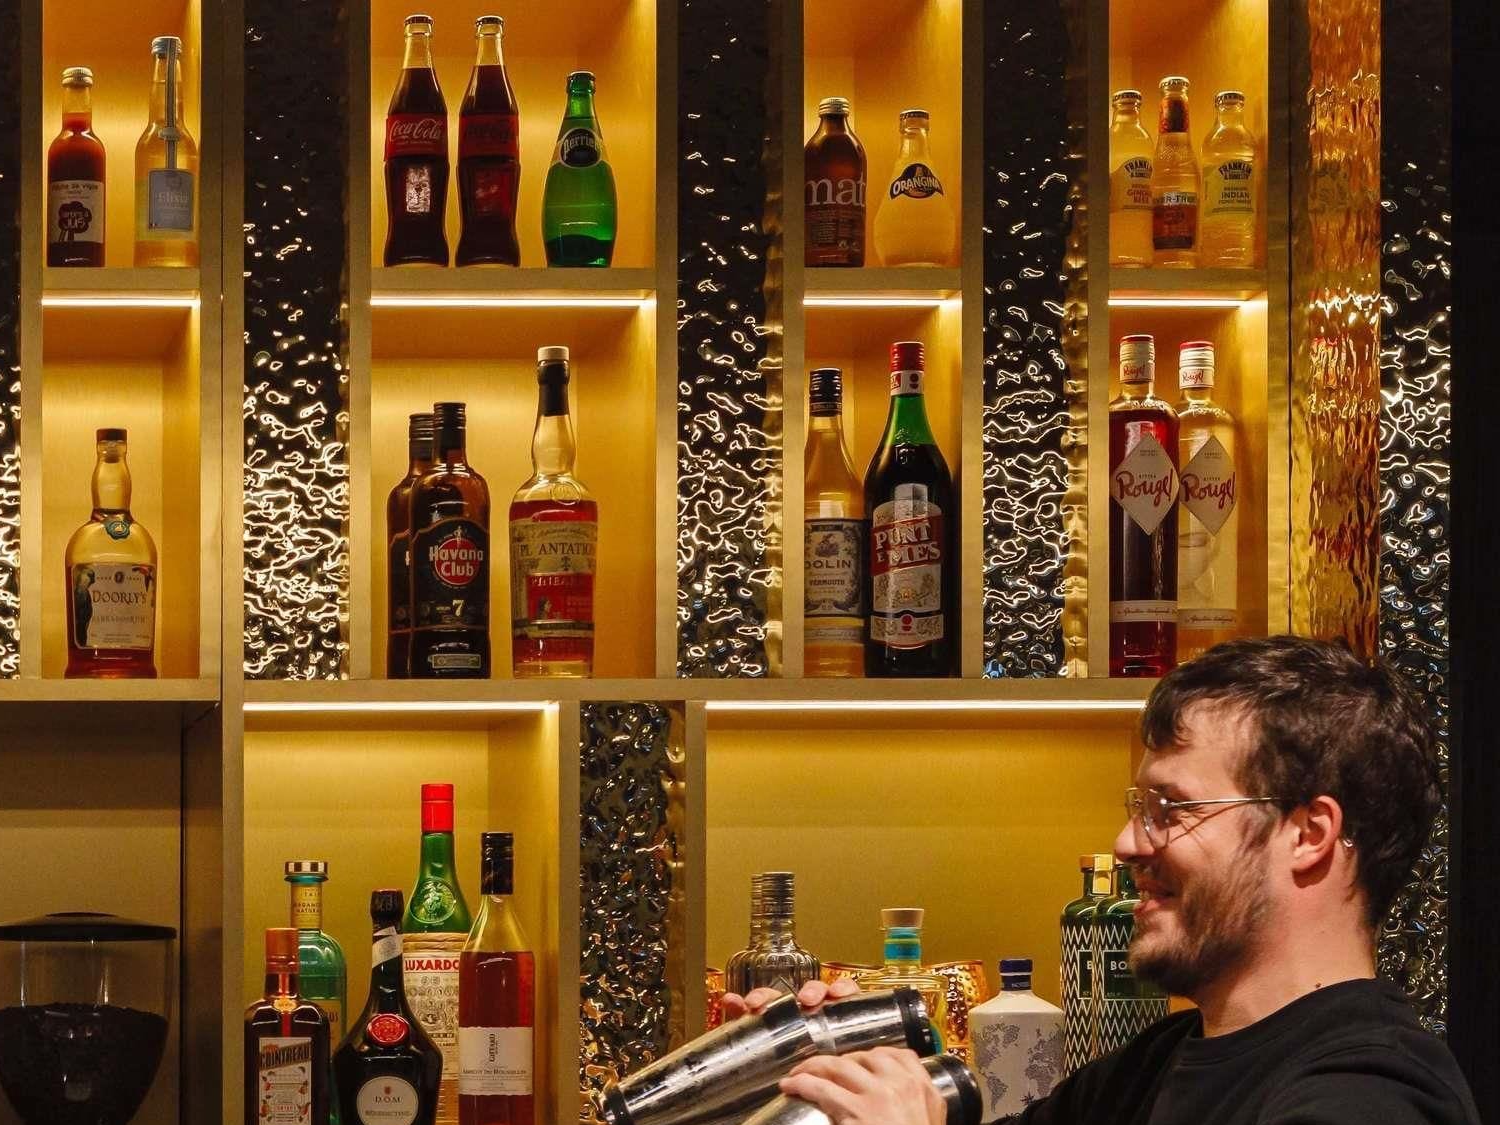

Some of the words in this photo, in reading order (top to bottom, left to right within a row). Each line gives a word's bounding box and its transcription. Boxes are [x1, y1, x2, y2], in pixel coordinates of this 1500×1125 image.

[390, 119, 442, 141] Coca-Cola
[892, 175, 942, 196] ORANGINA
[874, 523, 932, 550] PUNT
[429, 545, 484, 561] Havana
[441, 562, 475, 577] Club
[92, 590, 148, 605] DOORLY'S
[452, 599, 465, 617] 7
